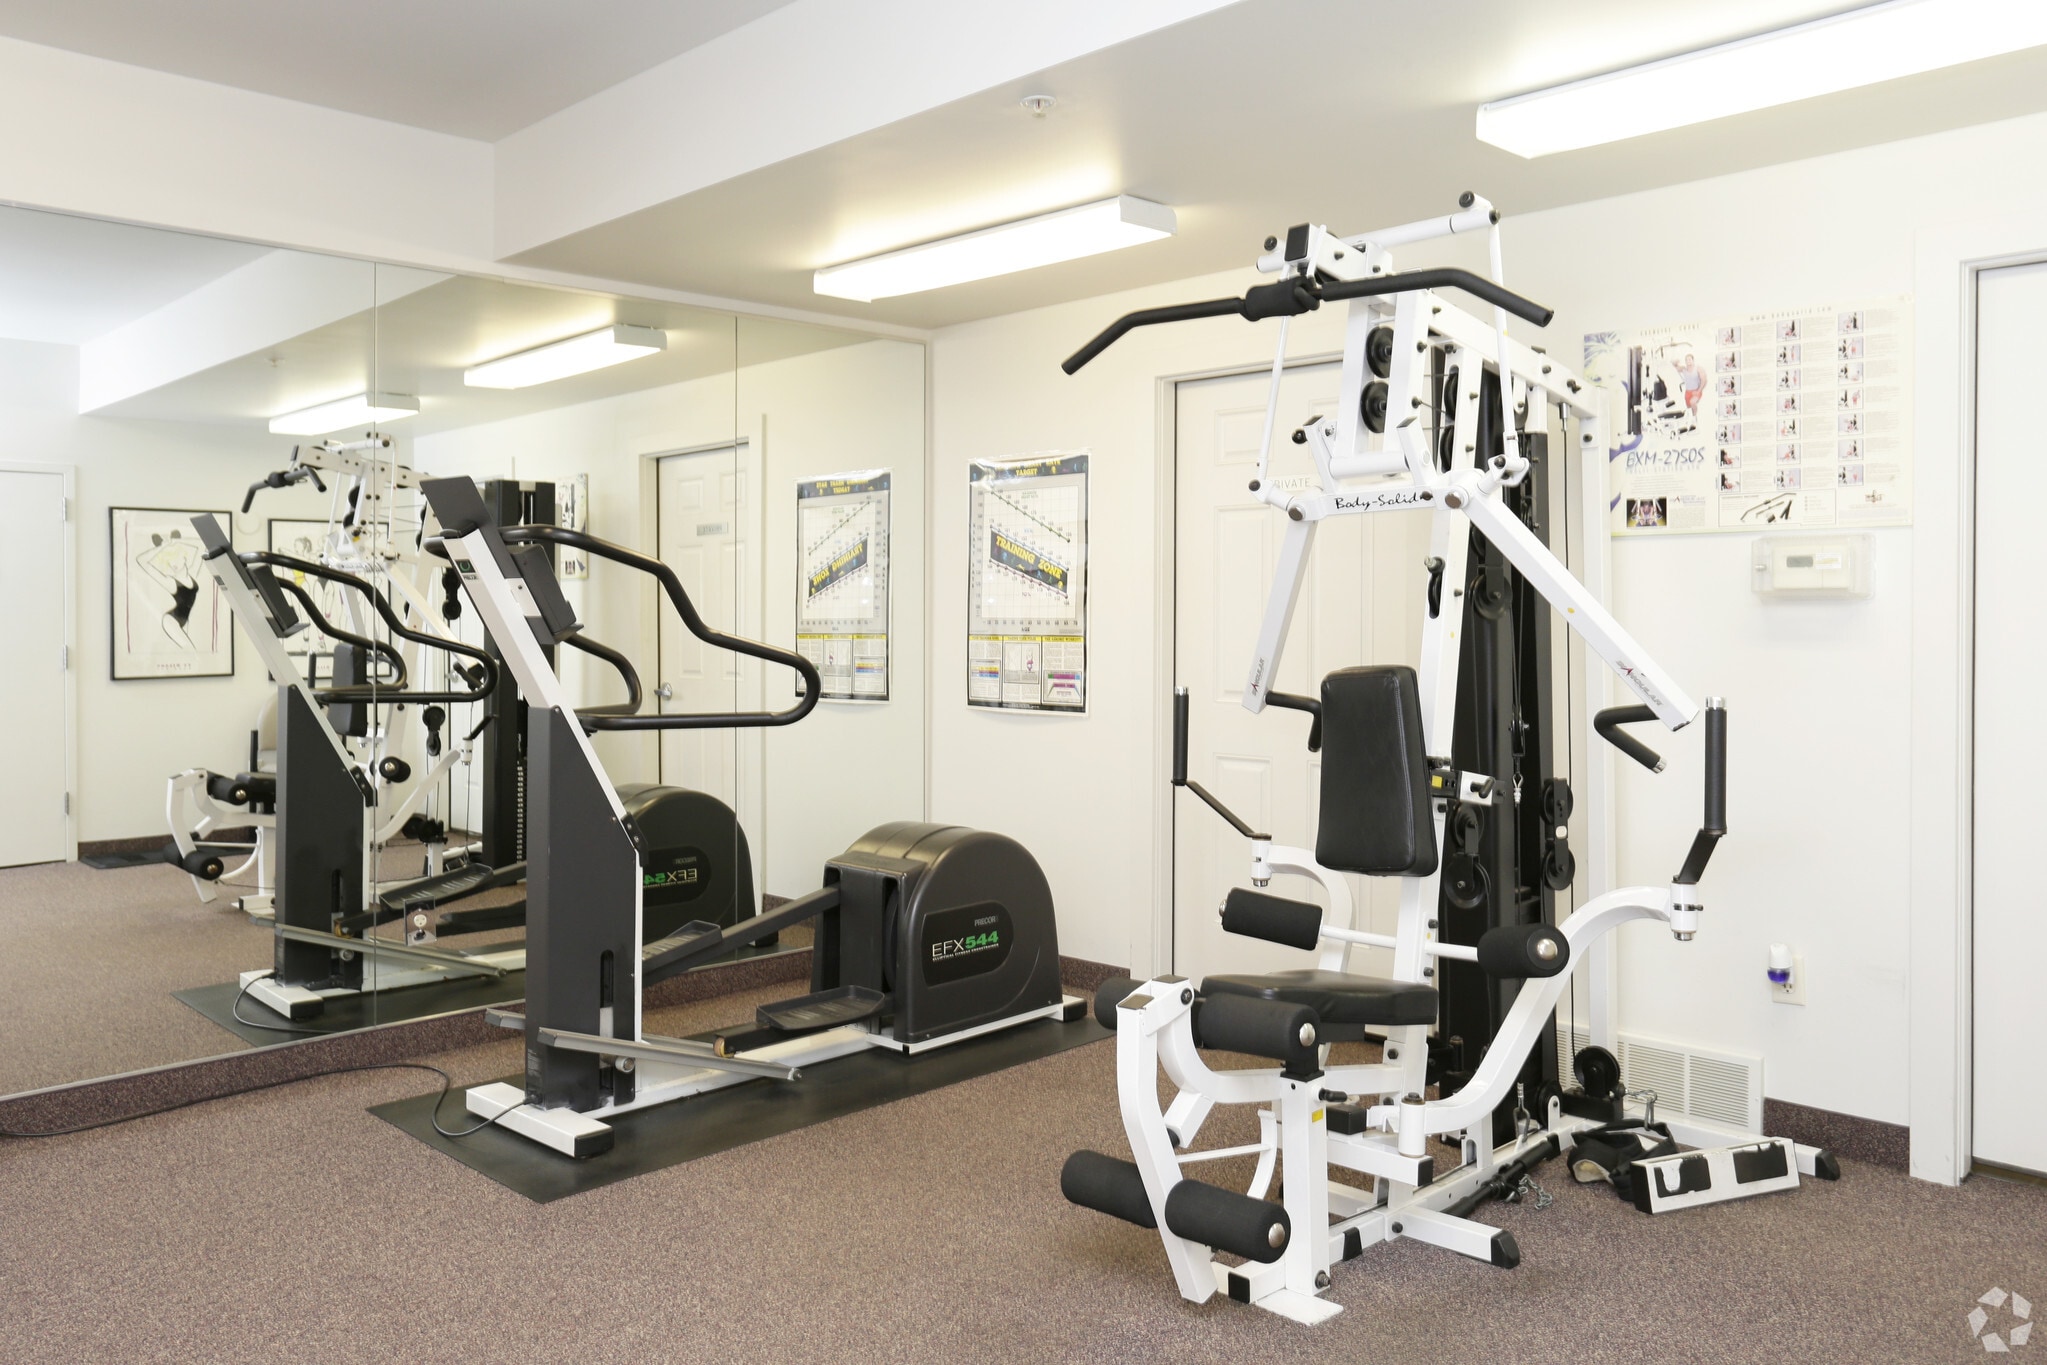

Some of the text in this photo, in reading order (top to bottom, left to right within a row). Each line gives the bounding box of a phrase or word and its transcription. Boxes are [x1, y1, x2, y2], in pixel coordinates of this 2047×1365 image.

[1016, 467, 1038, 477] TARGET
[1271, 477, 1311, 489] RIVATE
[996, 535, 1063, 580] TRAINING ZONE
[974, 915, 997, 927] PRECOR
